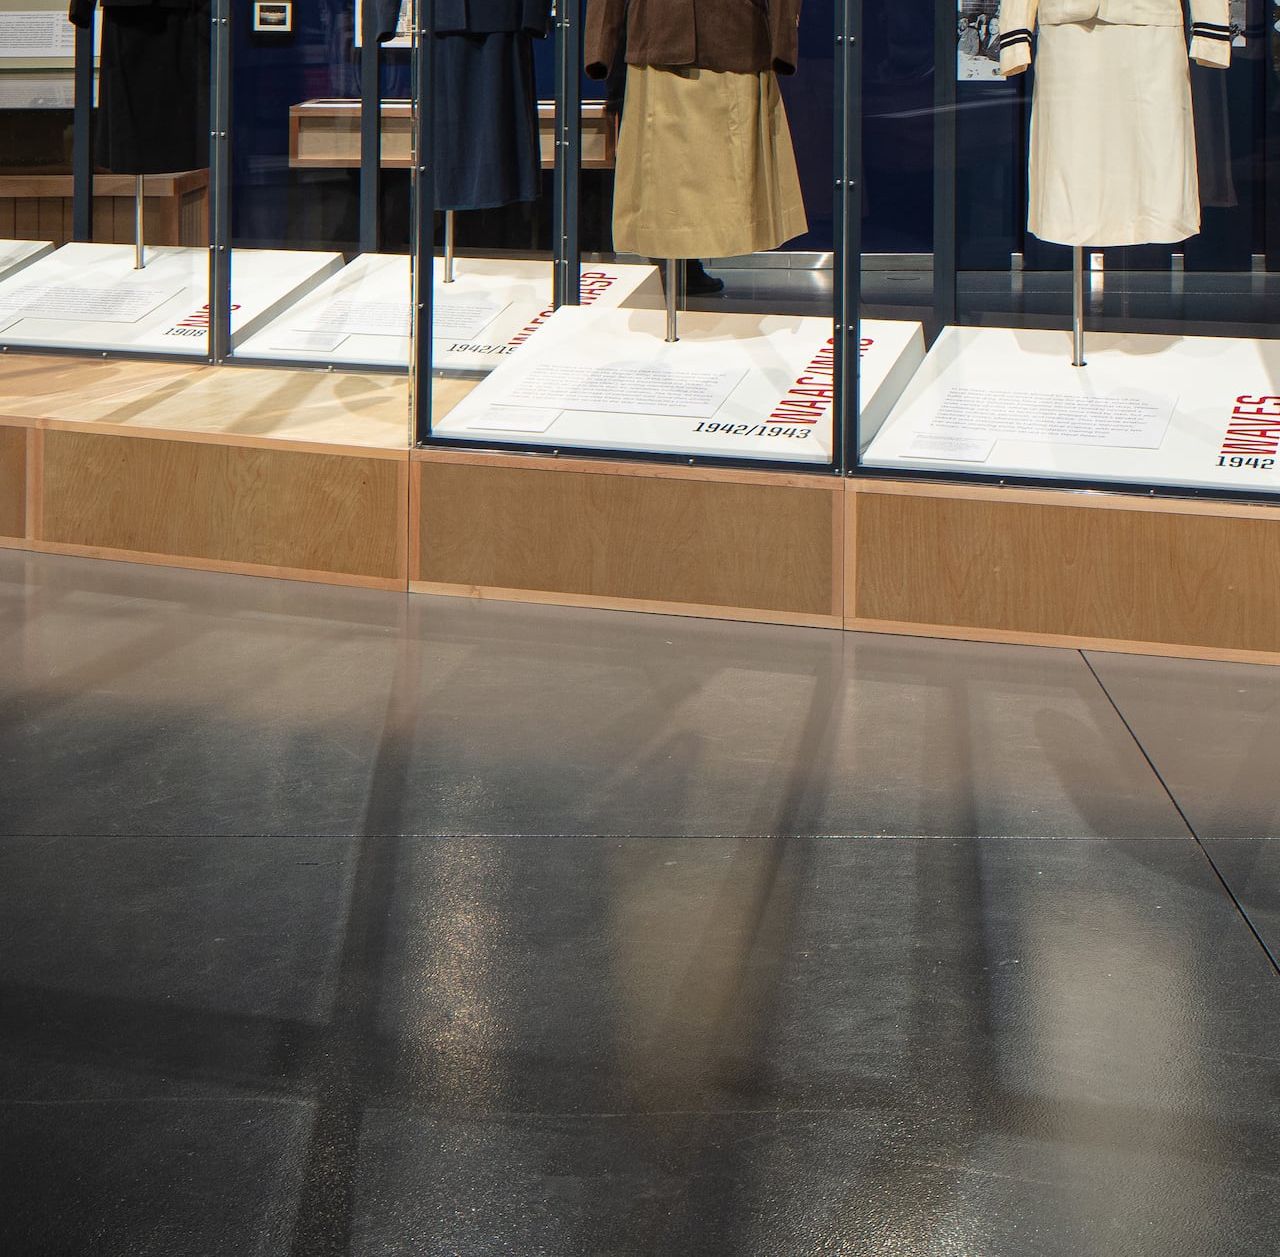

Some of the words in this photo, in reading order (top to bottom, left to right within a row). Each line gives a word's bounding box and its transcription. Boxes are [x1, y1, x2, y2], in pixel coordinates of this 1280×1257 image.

[162, 328, 207, 337] 1908
[692, 421, 811, 439] 1942/1943
[1215, 455, 1275, 470] 1942
